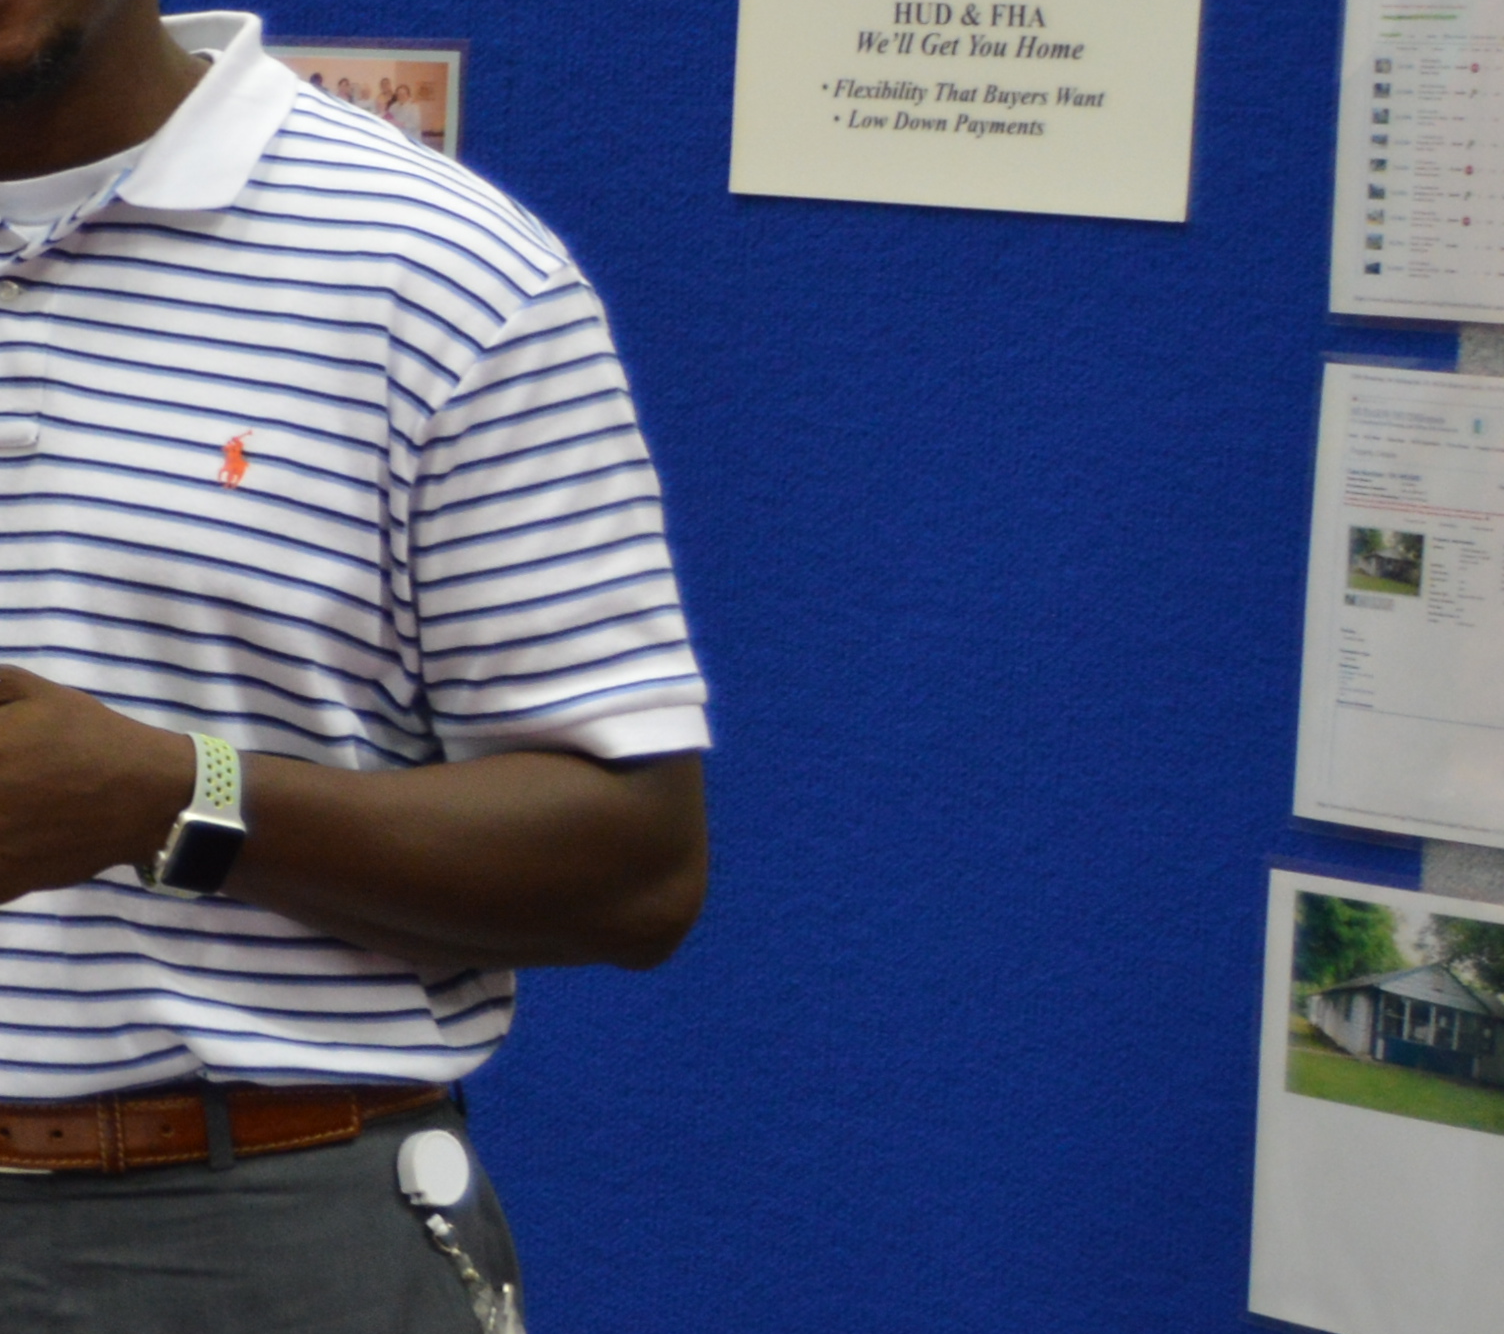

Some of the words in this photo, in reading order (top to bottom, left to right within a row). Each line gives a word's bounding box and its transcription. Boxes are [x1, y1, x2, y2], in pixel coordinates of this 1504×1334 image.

[894, 2, 953, 26] HUD
[960, 3, 981, 27] &
[991, 3, 1046, 28] FHA
[920, 32, 960, 56] Get
[969, 33, 1008, 58] You
[1015, 35, 1085, 60] Home
[833, 78, 929, 107] Flexibility
[935, 82, 978, 103] That
[982, 83, 1049, 110] Buyers
[1056, 86, 1105, 108] Want
[847, 108, 889, 129] Low
[892, 110, 948, 132] Down
[953, 113, 1044, 139] Payments
